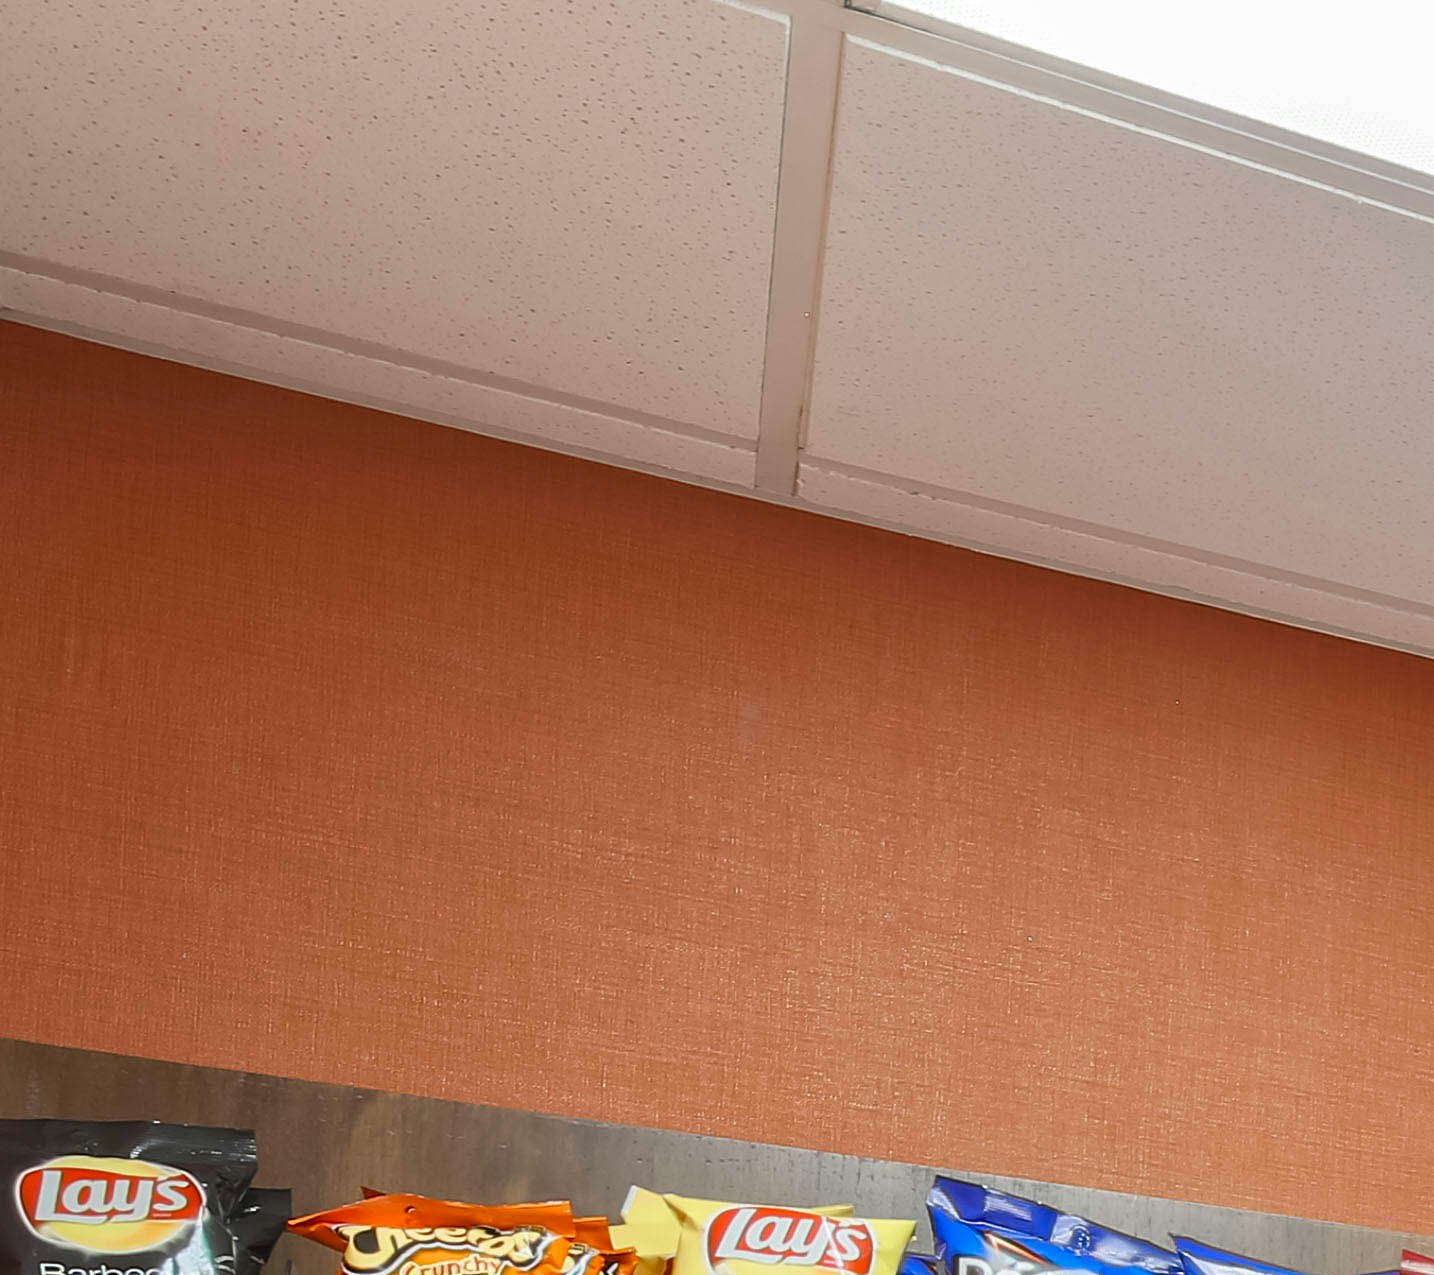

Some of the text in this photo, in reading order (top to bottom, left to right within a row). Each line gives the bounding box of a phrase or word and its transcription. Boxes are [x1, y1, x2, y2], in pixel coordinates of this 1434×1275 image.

[35, 1170, 190, 1223] Lay's
[342, 1223, 552, 1275] Cheetos
[714, 1207, 868, 1267] Lay's
